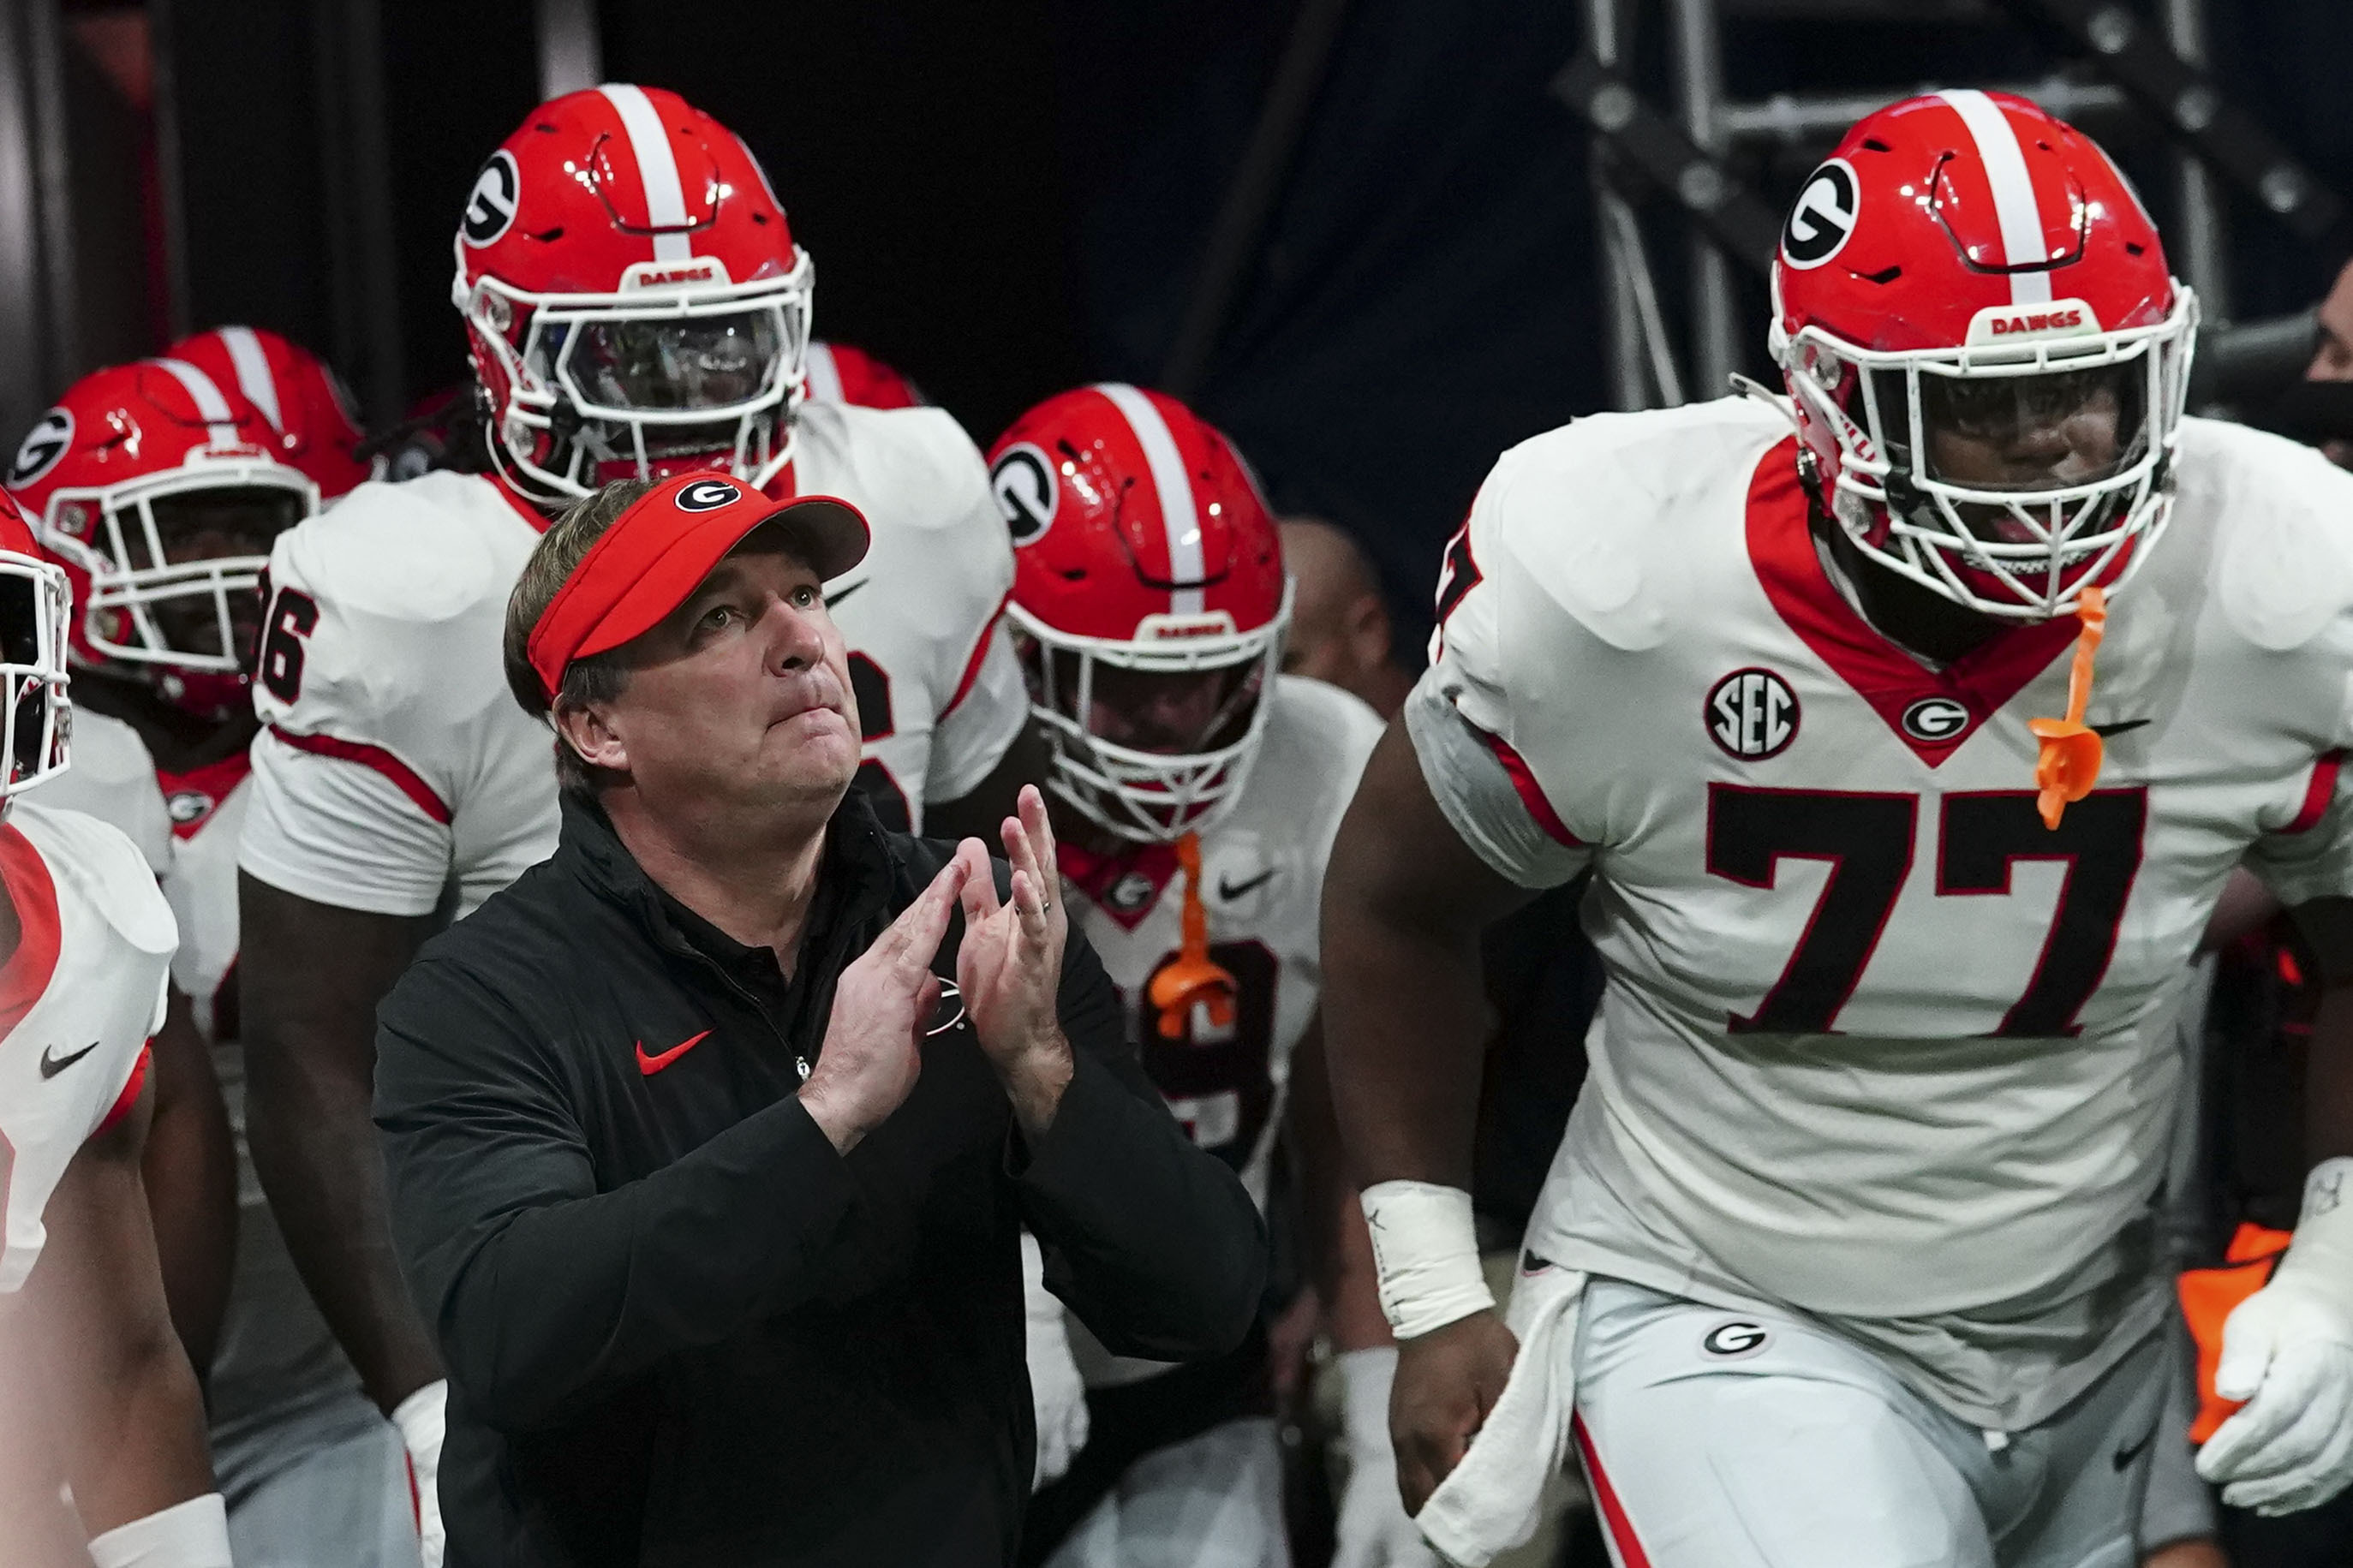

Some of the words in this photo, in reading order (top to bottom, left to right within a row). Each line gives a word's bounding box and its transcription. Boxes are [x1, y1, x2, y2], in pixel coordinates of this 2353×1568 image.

[464, 155, 515, 246] G
[1783, 164, 1854, 261] G
[1991, 309, 2081, 335] DAWGS
[678, 480, 740, 510] G
[260, 565, 320, 706] 6
[1713, 673, 1793, 754] SEC
[1904, 701, 1967, 736] G
[1706, 781, 2148, 1039] 77
[1704, 1322, 1766, 1354] G
